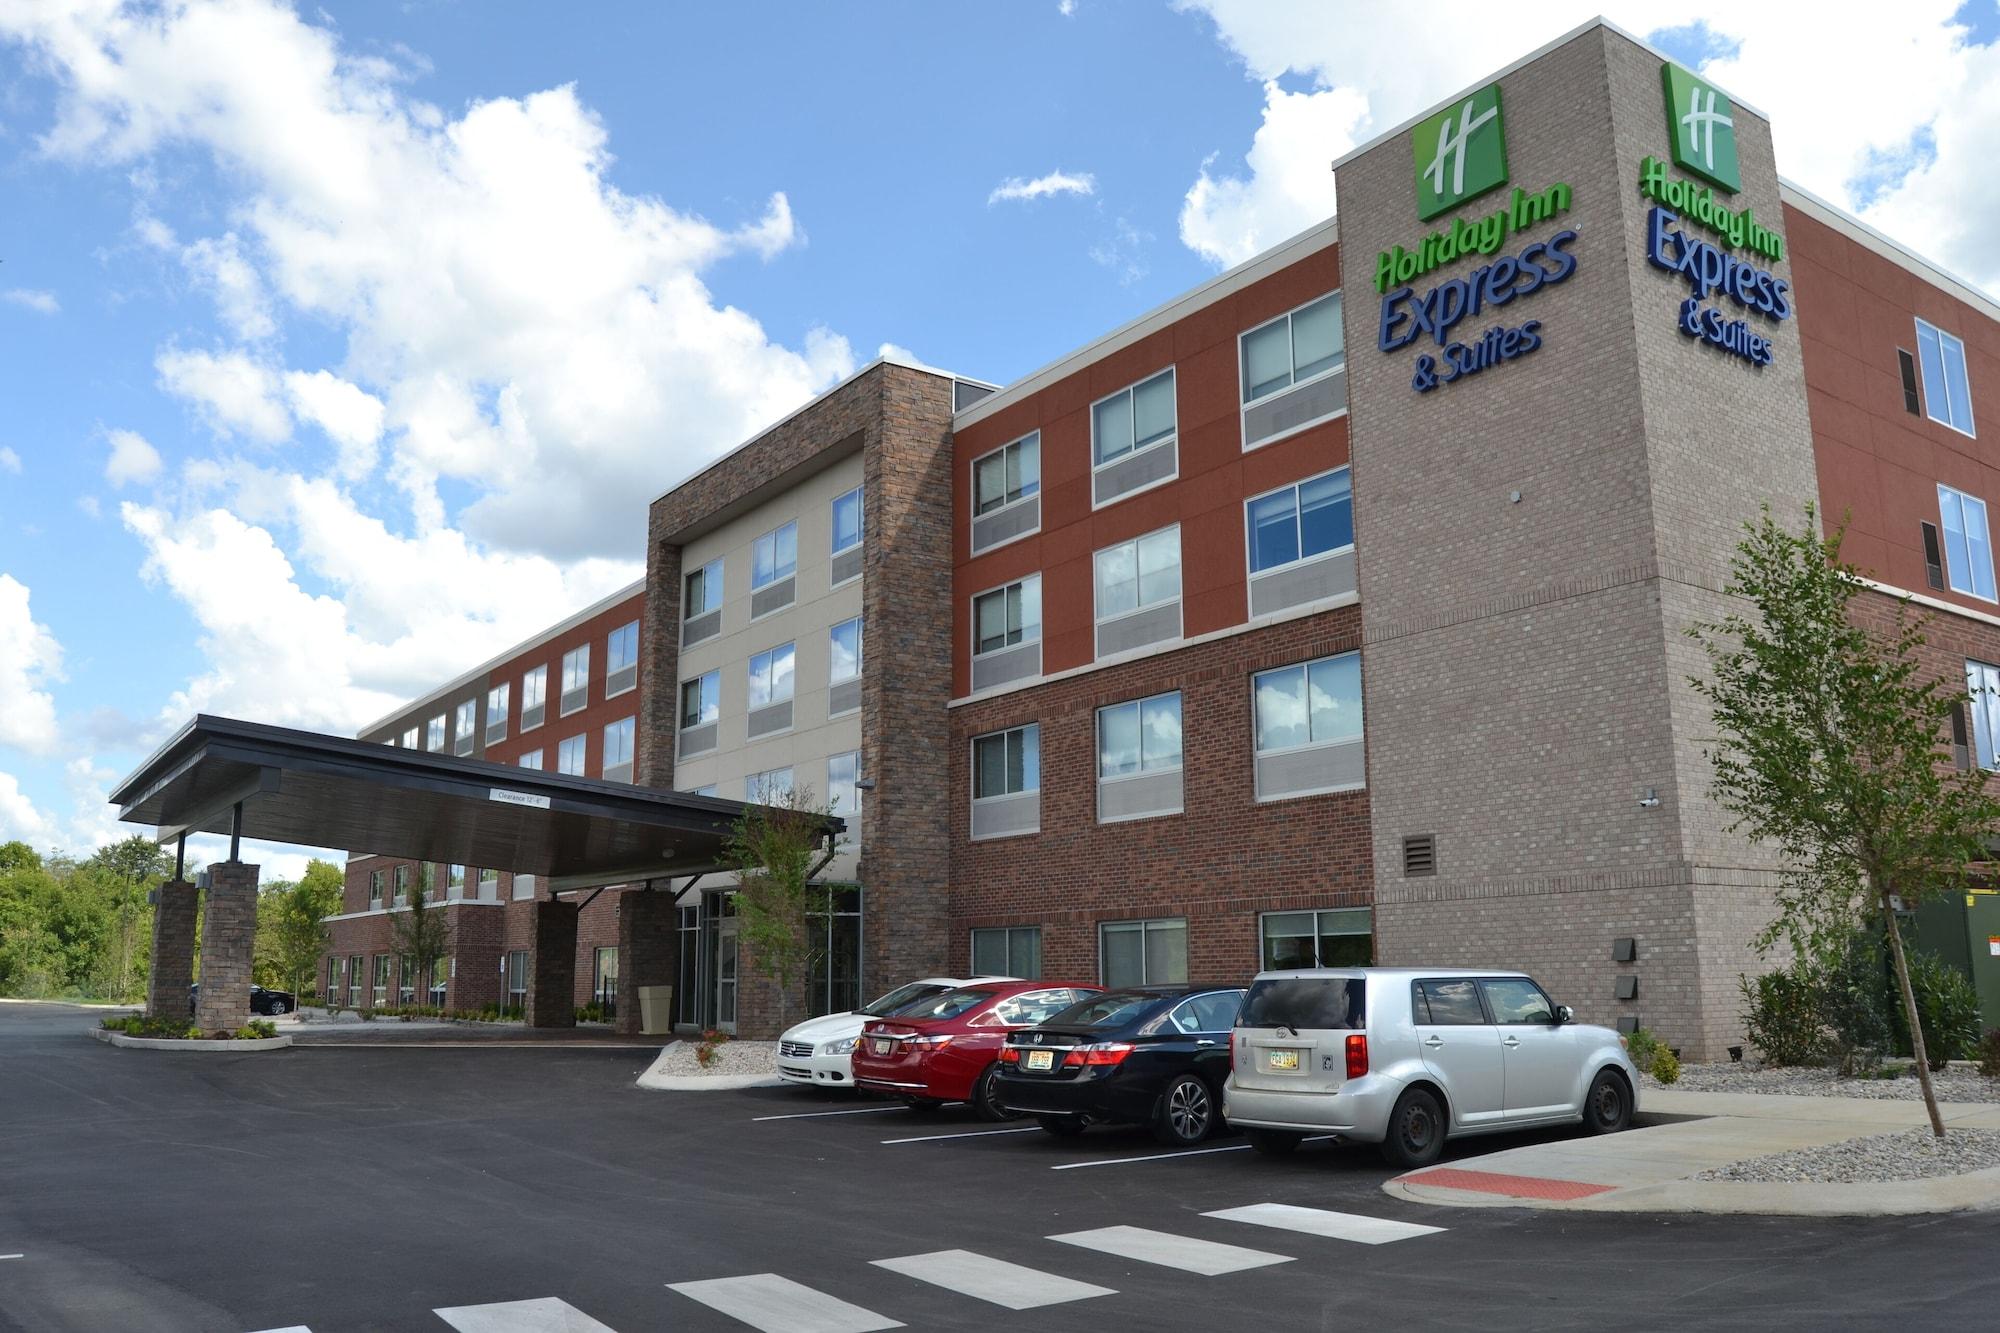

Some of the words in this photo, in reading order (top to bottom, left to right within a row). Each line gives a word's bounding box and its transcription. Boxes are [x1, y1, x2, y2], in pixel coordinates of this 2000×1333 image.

[1373, 211, 1507, 293] Holiday
[1510, 182, 1572, 232] Inn
[1640, 155, 1743, 248] Holiday
[1740, 208, 1783, 261] Inn
[1378, 229, 1577, 352] Express
[1648, 206, 1791, 321] Express
[1412, 355, 1438, 392] &
[1440, 319, 1542, 383] Suites
[1680, 297, 1703, 337] &
[1701, 307, 1774, 367] Suites
[498, 791, 525, 801] Clearance
